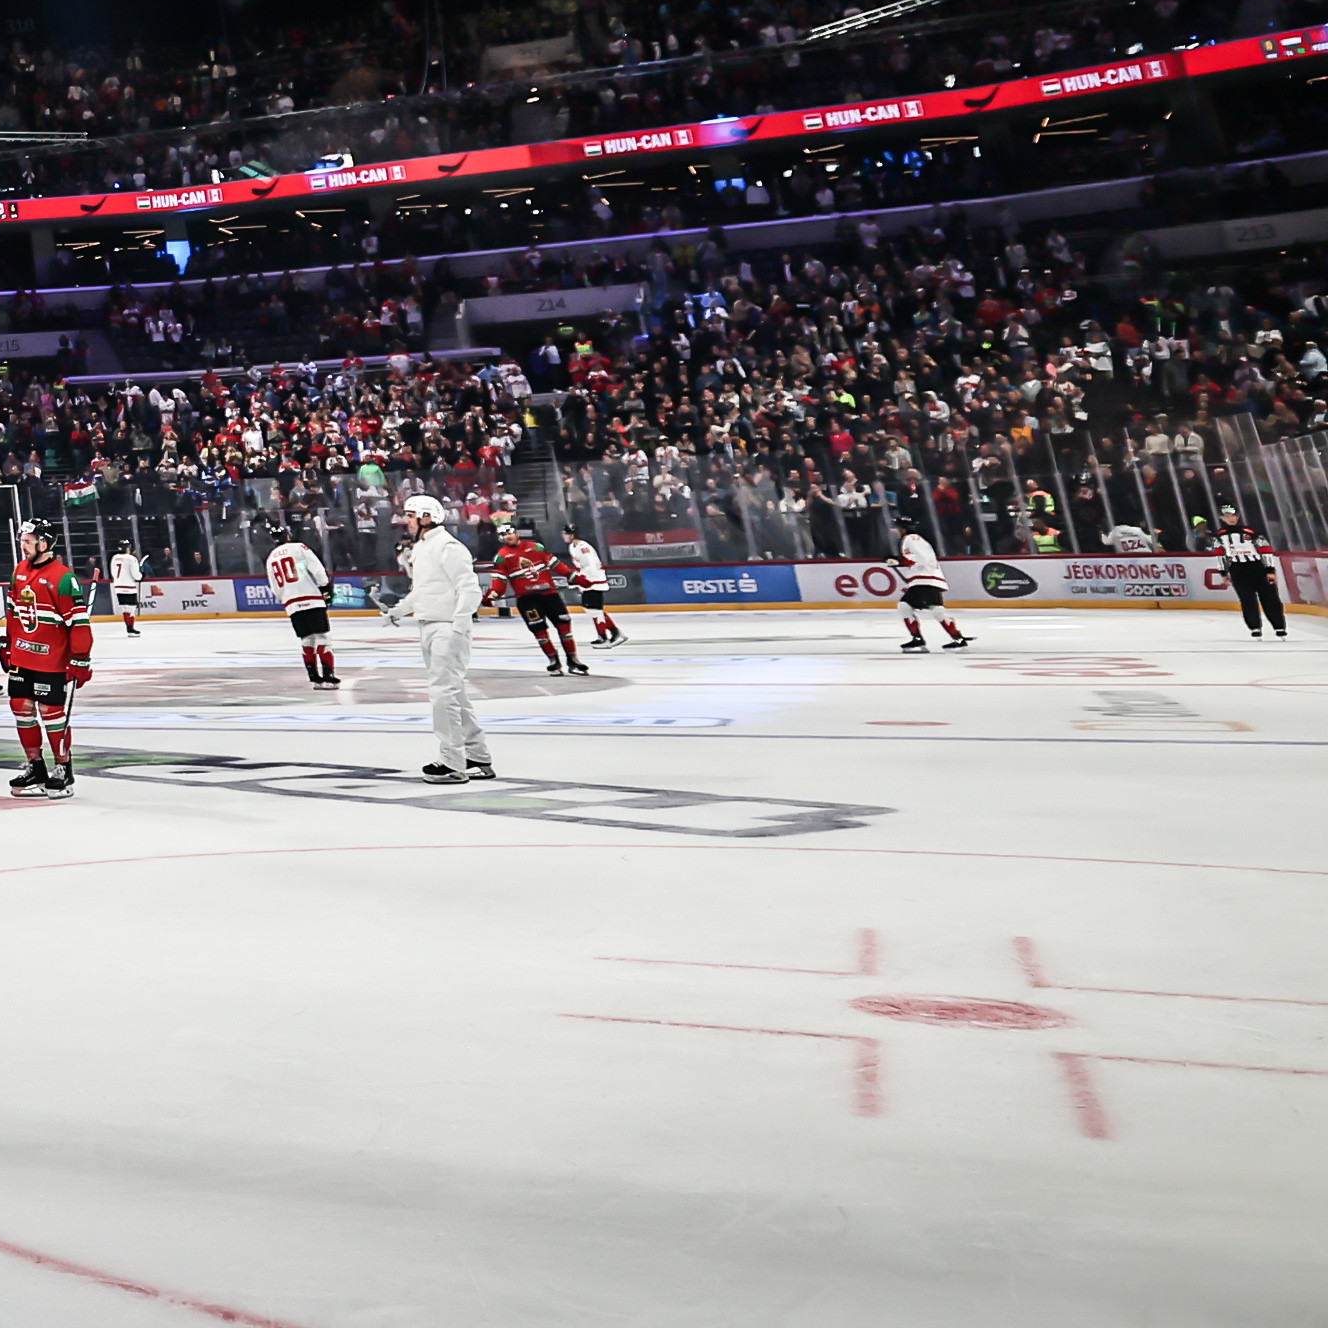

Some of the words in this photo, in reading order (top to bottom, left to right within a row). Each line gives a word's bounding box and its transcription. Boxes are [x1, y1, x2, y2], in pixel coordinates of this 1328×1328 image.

[1062, 65, 1143, 94] HUN-CAN
[825, 102, 901, 130] HUN-CAN
[604, 132, 673, 157] HUN-CAN
[328, 167, 388, 189] HUN-CAN
[151, 190, 207, 210] HUN-CAN
[1235, 224, 1276, 243] 213
[537, 297, 567, 312] 214
[115, 564, 122, 579] 7
[1064, 561, 1187, 580] JÉGKORONG-VB
[245, 585, 275, 598] BAY
[682, 579, 735, 594] ERSTE
[182, 598, 208, 610] pwc
